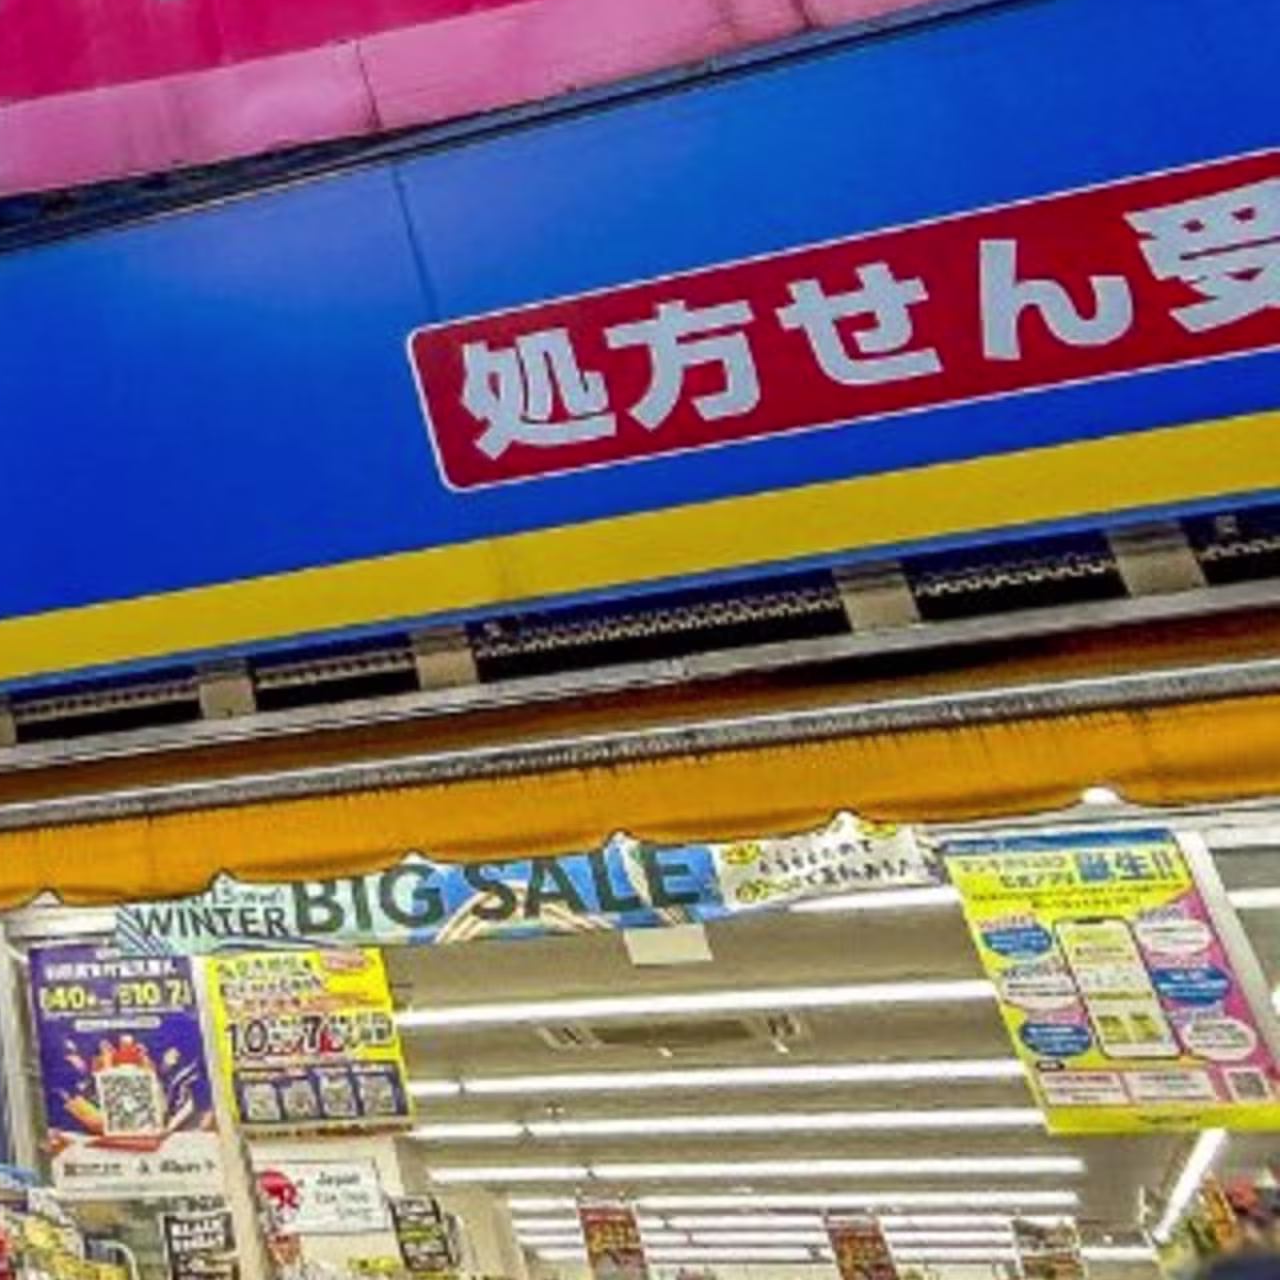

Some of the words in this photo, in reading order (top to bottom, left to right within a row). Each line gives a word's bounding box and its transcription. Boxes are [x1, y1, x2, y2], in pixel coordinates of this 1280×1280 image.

[459, 178, 1280, 462] 処方せん受
[134, 906, 289, 939] WINTER
[292, 863, 448, 933] BIG
[470, 842, 702, 923] SALE
